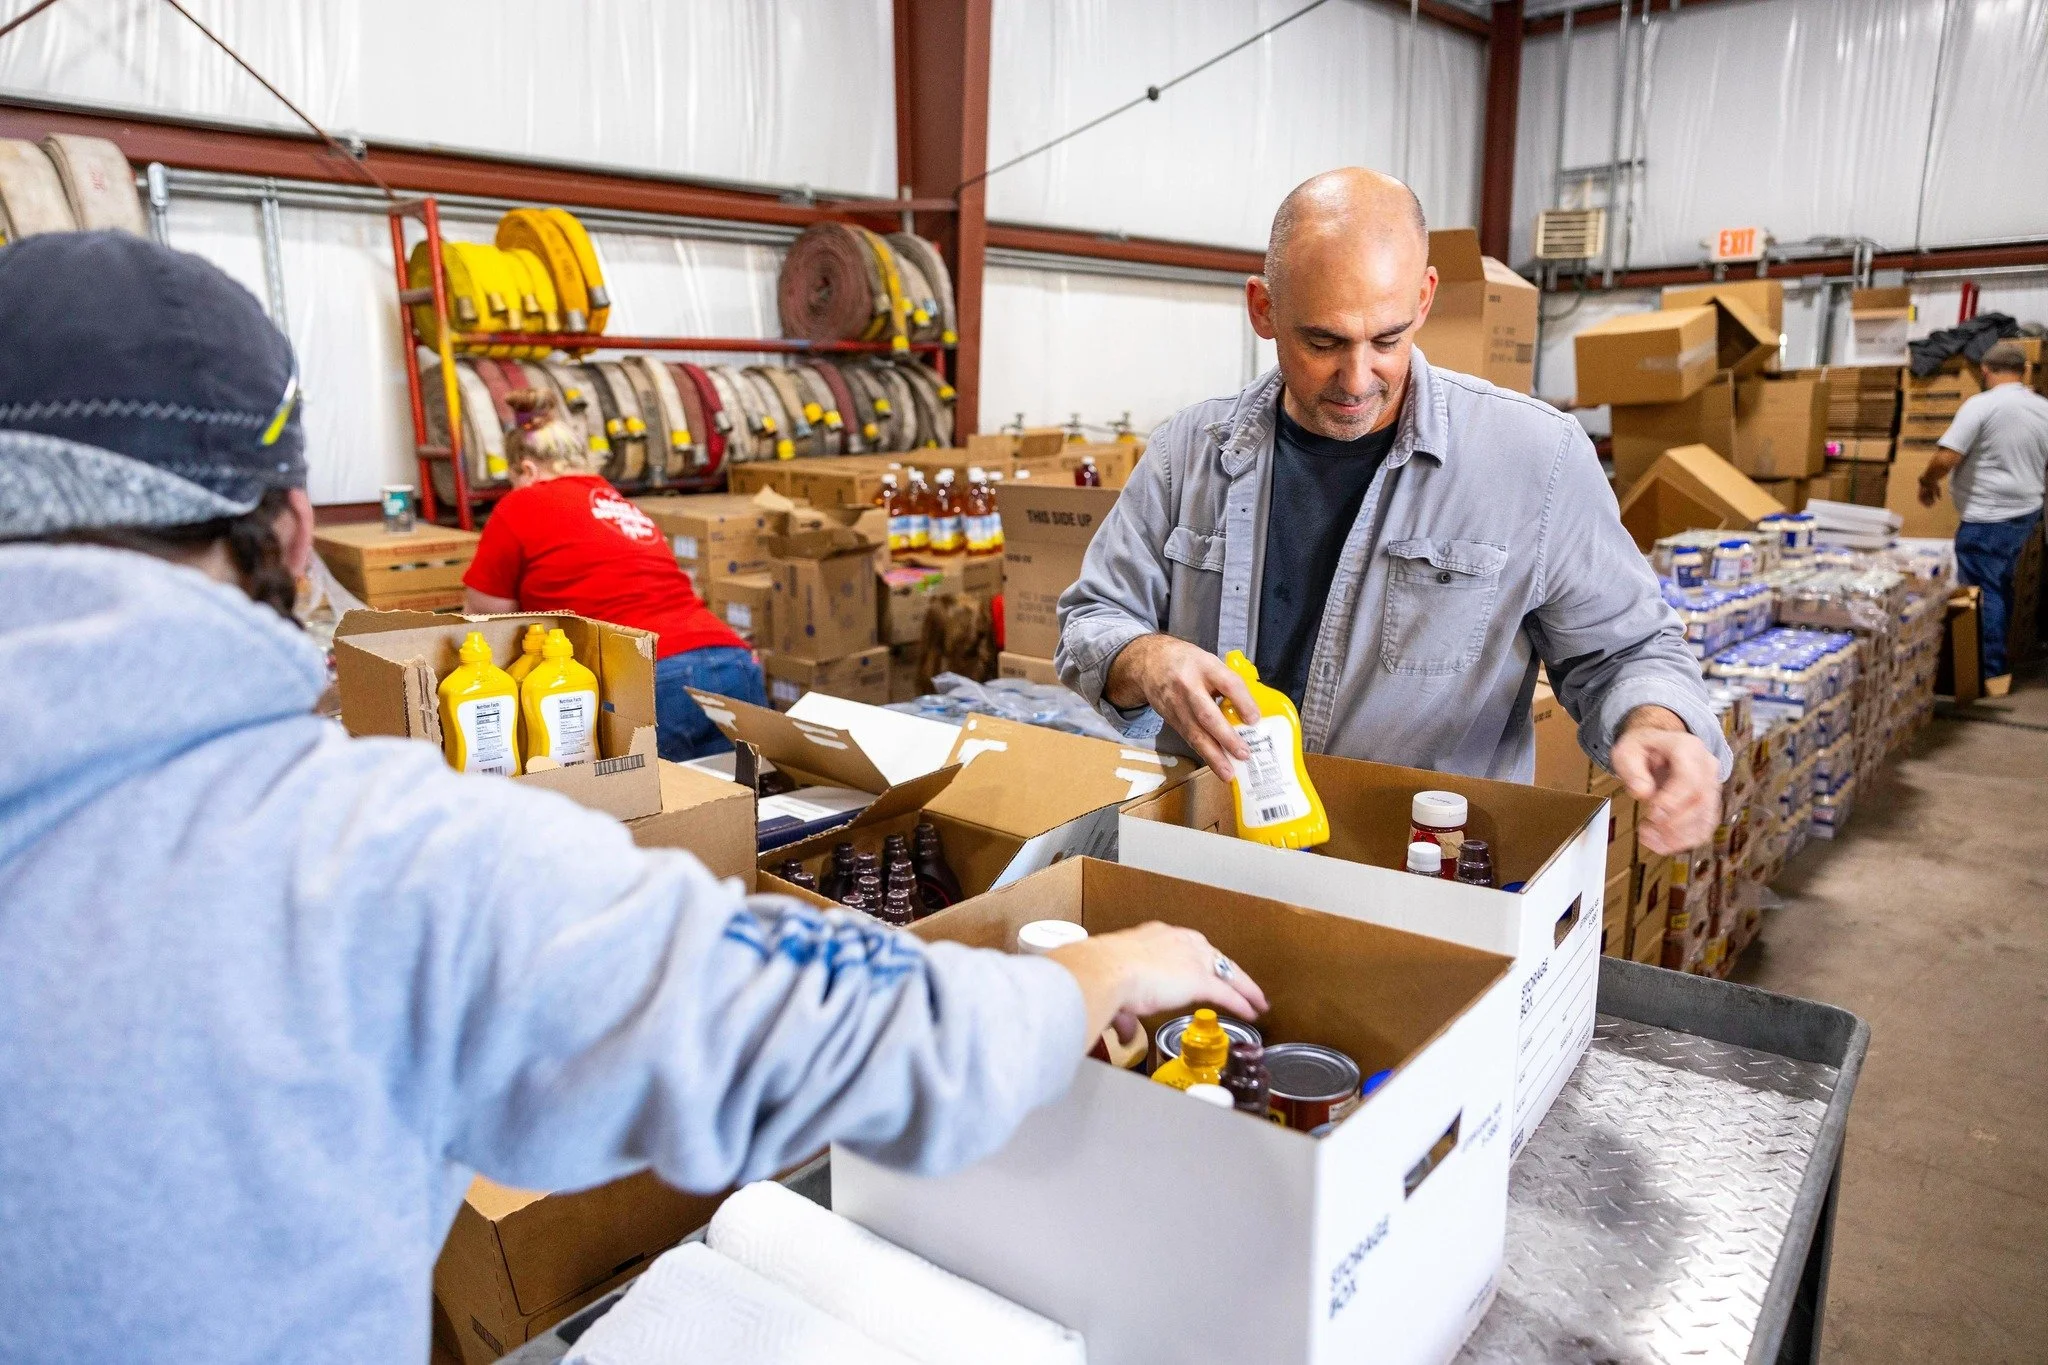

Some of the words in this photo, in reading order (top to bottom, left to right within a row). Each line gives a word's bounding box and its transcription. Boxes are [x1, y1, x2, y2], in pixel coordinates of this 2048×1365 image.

[1719, 228, 1755, 256] EXIT
[1027, 509, 1049, 524] THIS
[1052, 510, 1076, 526] SIDE
[1077, 513, 1092, 527] UP
[1520, 957, 1549, 1001] STORAGE
[1520, 995, 1534, 1020] BOX
[1330, 1212, 1390, 1292] STORAGE
[1329, 1278, 1357, 1320] BOX
